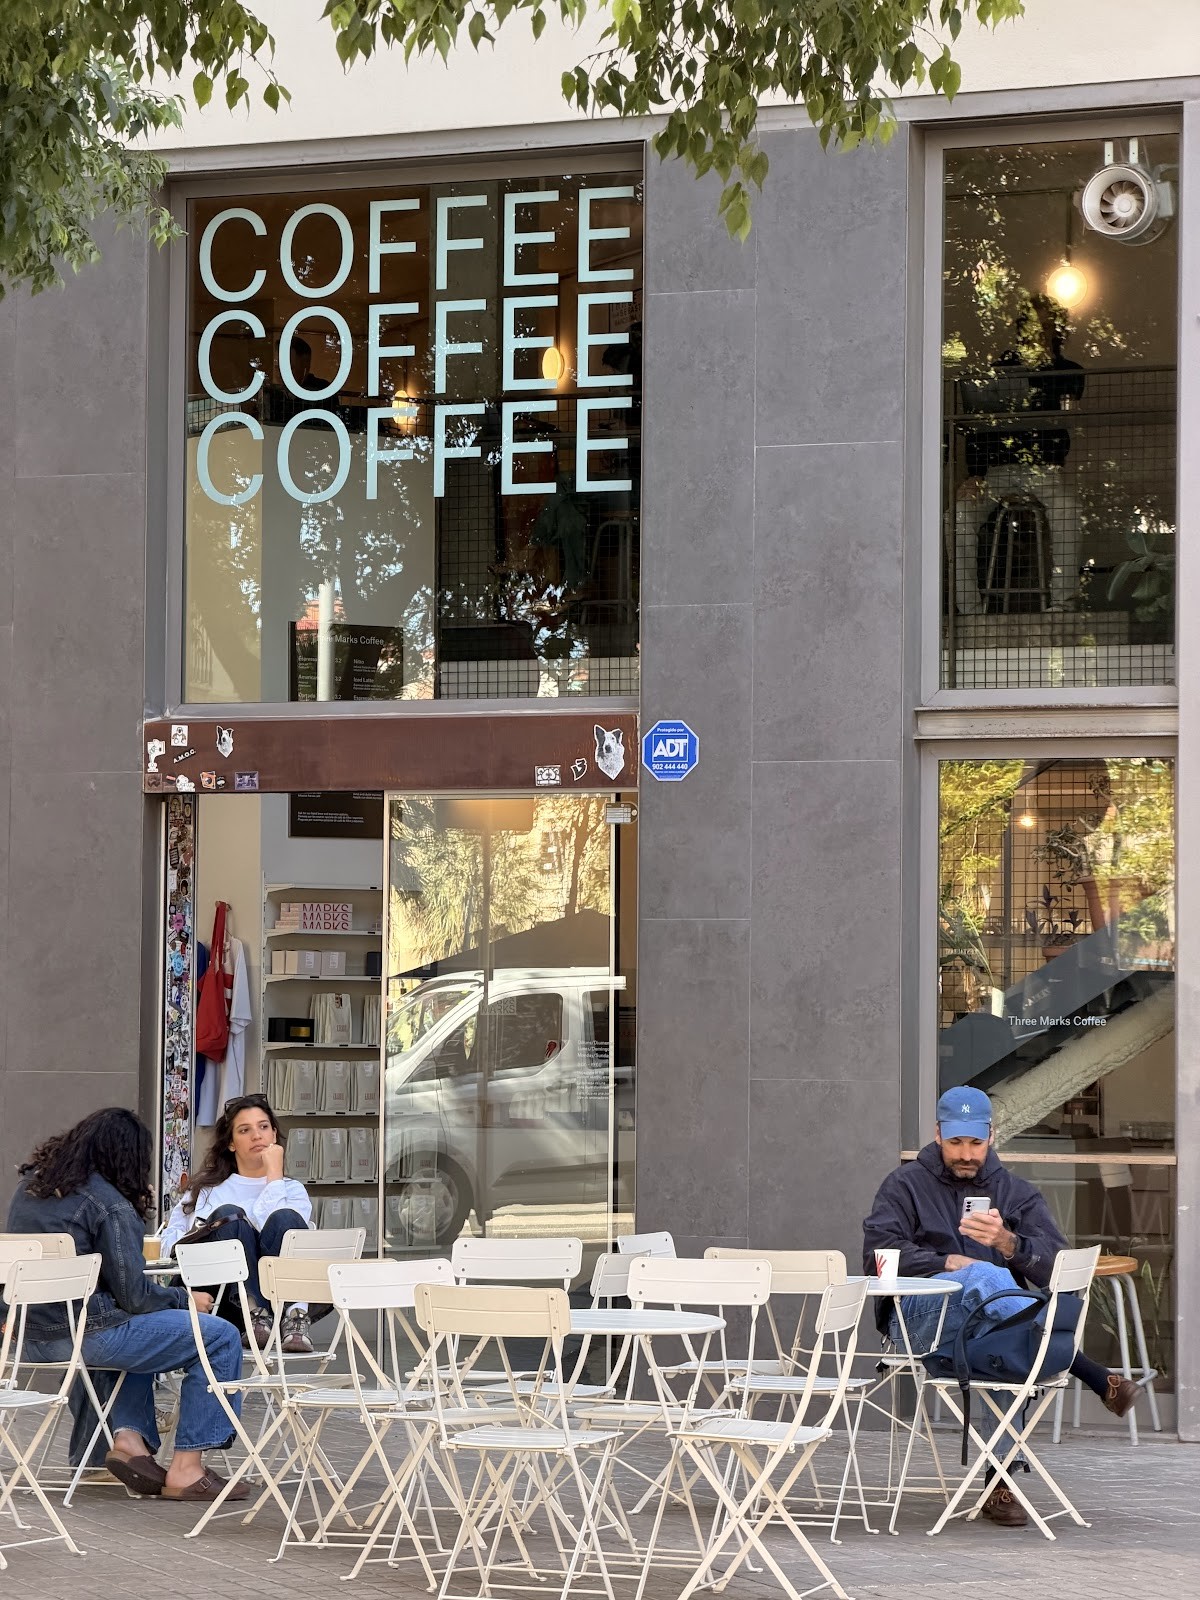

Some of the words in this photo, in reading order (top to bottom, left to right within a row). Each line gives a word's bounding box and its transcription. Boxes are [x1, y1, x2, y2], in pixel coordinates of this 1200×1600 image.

[199, 186, 634, 302] COFFEE
[198, 291, 634, 404] COFFEE
[196, 397, 633, 506] COFFEE
[335, 634, 358, 644] Marks
[360, 635, 384, 646] Coffee
[653, 738, 688, 758] ADT
[1008, 1016, 1037, 1026] Three
[1039, 1016, 1071, 1026] Marks
[1073, 1016, 1107, 1026] Coffee
